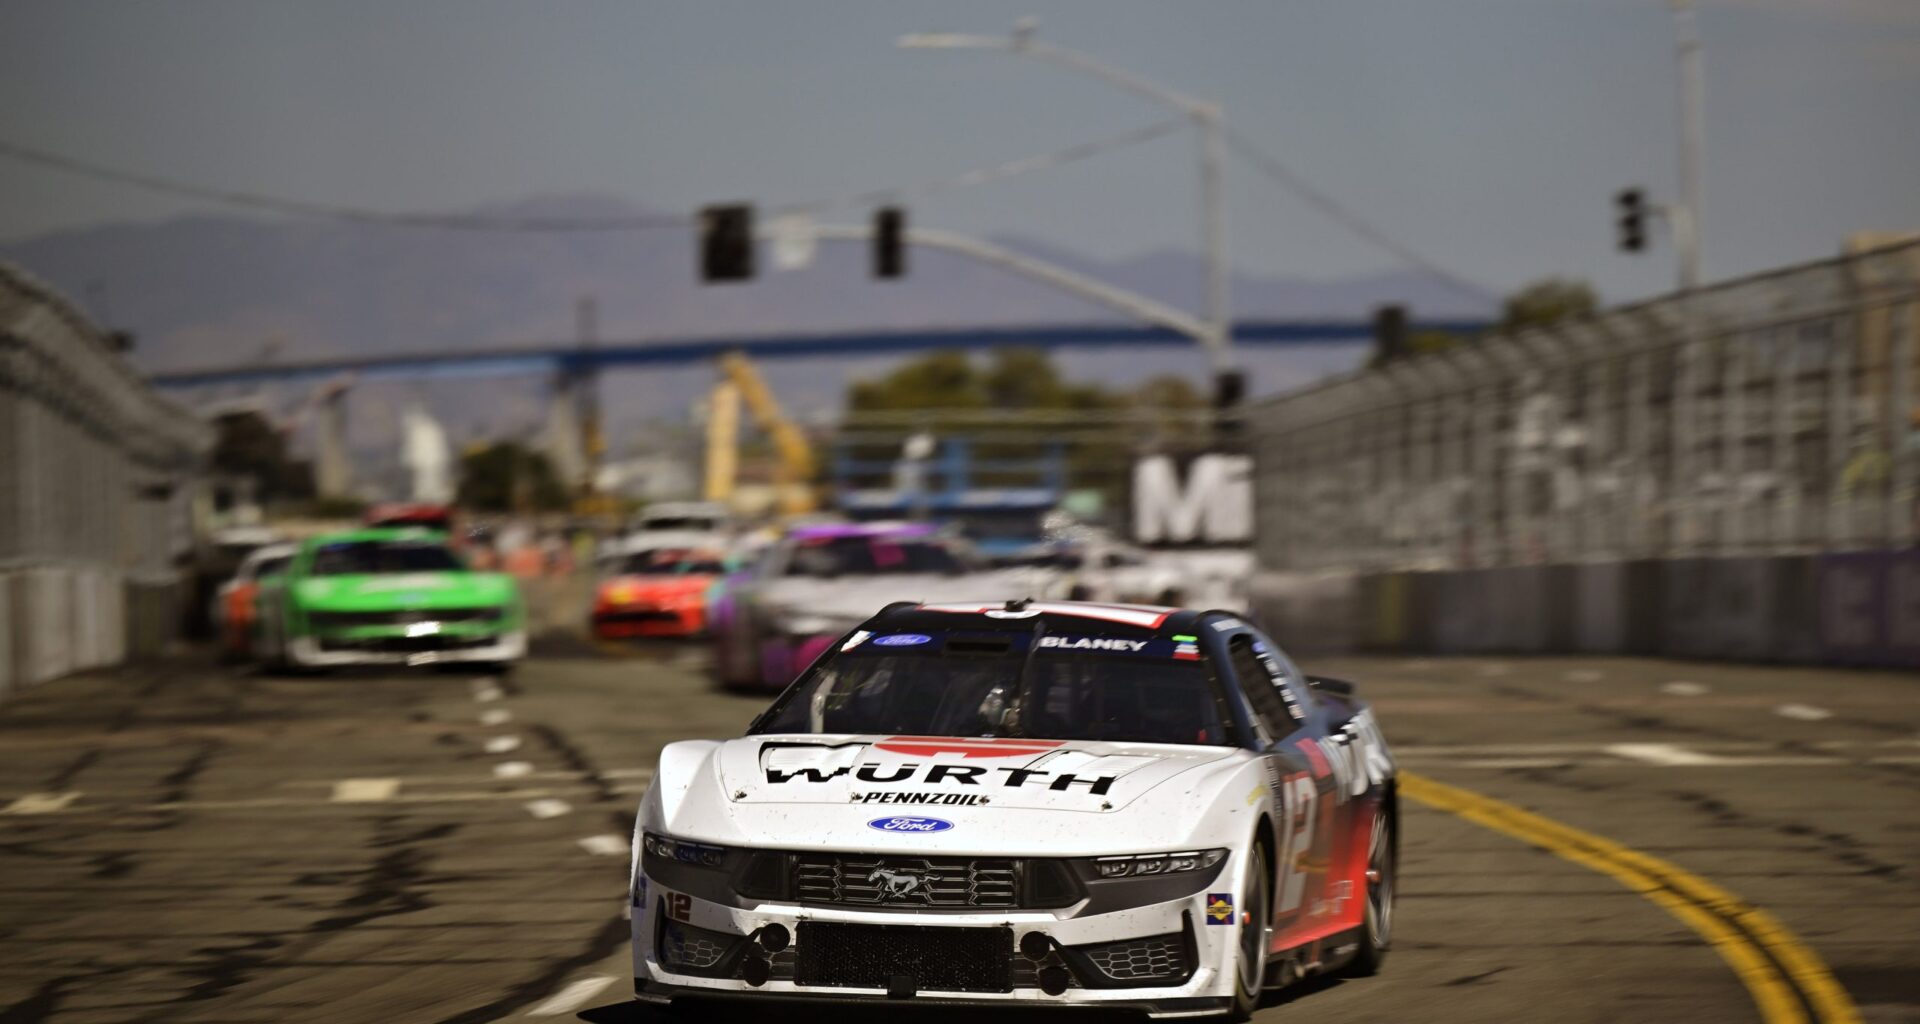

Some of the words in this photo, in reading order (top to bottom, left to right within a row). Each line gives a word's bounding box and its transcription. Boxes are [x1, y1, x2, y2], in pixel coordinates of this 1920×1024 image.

[1039, 636, 1148, 652] BLANEY
[862, 792, 979, 806] PENNZOIL
[883, 818, 938, 831] Ford
[666, 891, 692, 922] 12
